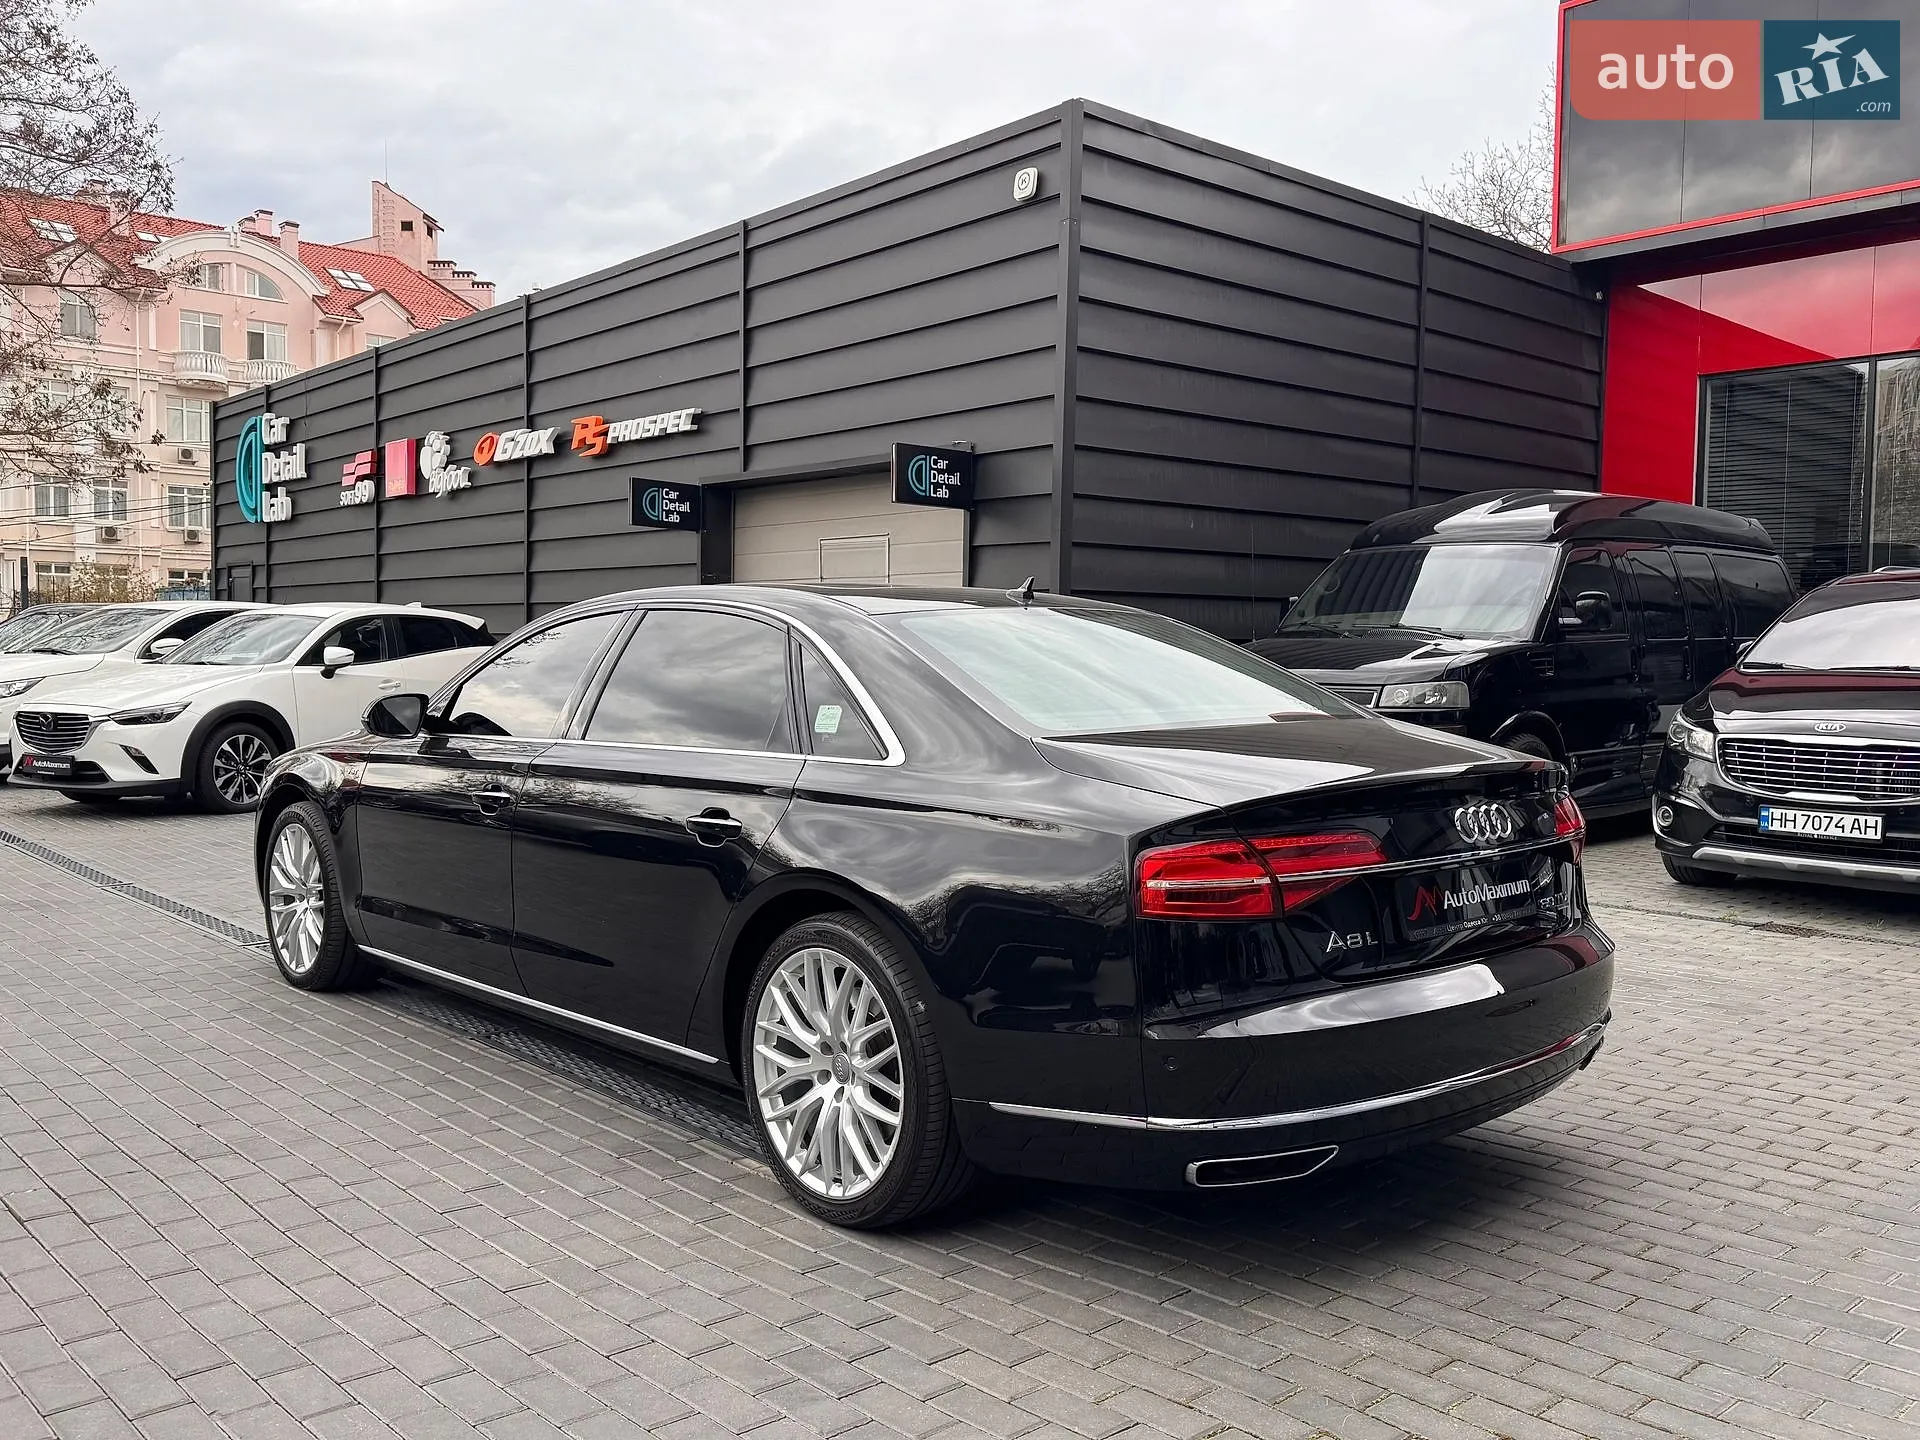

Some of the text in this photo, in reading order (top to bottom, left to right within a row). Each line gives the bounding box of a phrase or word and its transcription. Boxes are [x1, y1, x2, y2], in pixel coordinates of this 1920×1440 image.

[262, 412, 290, 445] Car
[606, 407, 702, 444] PROSPEC
[262, 443, 307, 484] Detail
[930, 455, 949, 470] Car
[930, 470, 961, 486] Detail
[662, 487, 680, 500] Car
[930, 484, 949, 499] Lab
[262, 487, 292, 523] Lab
[662, 499, 691, 513] Detail
[662, 511, 681, 523] Lab
[1770, 811, 1879, 837] HH 7074 AH
[1443, 879, 1531, 910] AutoMaximum
